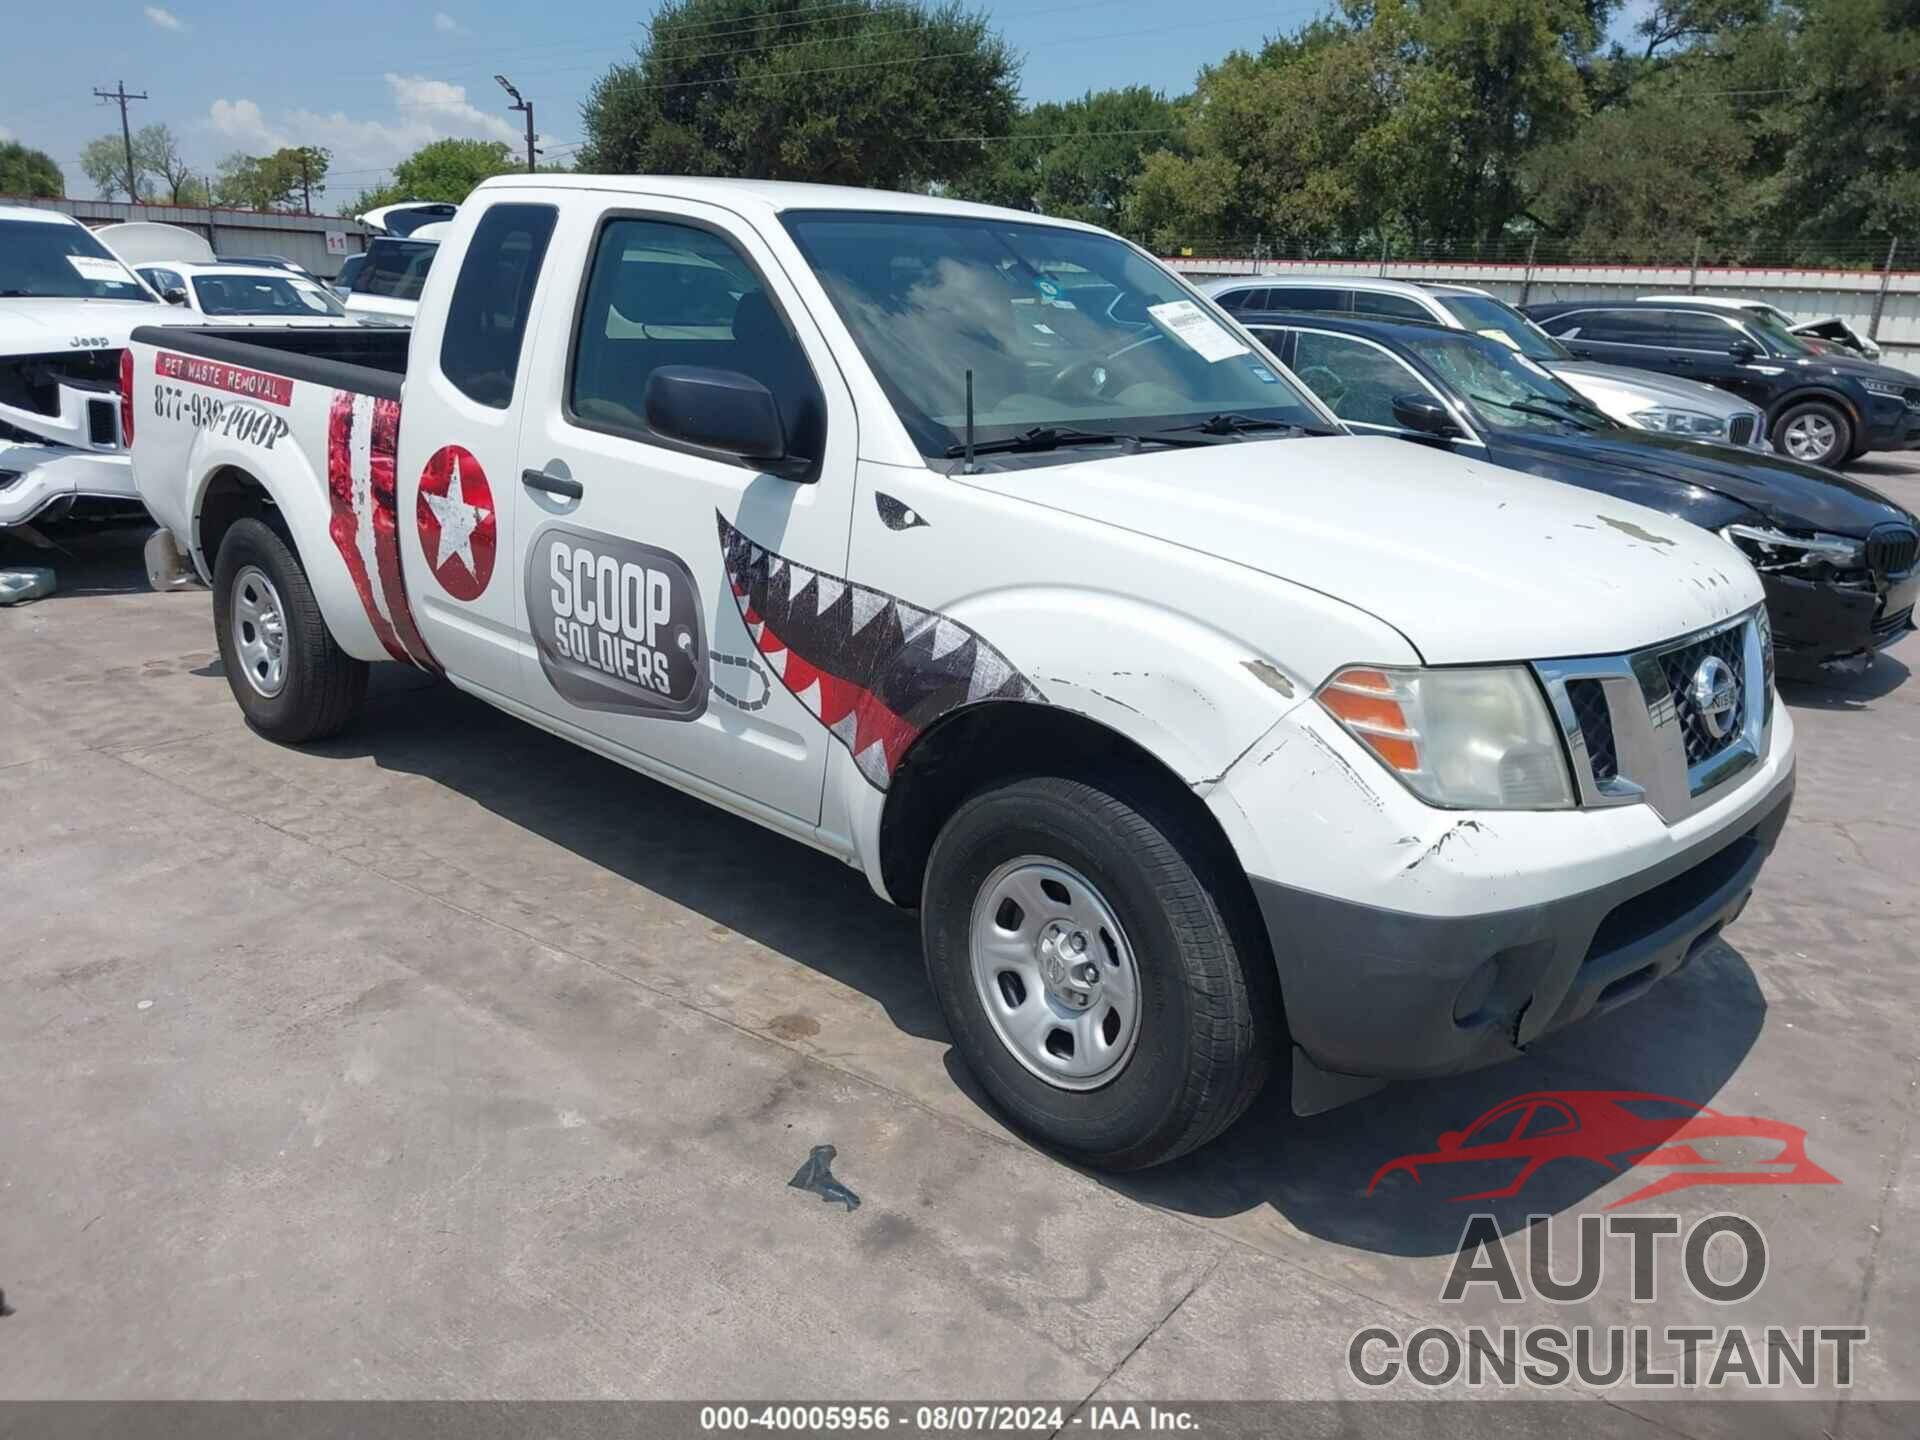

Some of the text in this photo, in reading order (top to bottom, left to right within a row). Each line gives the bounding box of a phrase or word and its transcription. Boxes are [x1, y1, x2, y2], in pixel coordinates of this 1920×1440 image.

[328, 237, 345, 249] 11
[70, 336, 109, 347] Jeep
[164, 357, 279, 399] PET WASTE REMOVAL
[550, 541, 671, 648] SCOOP
[553, 616, 671, 695] SOLDIERS
